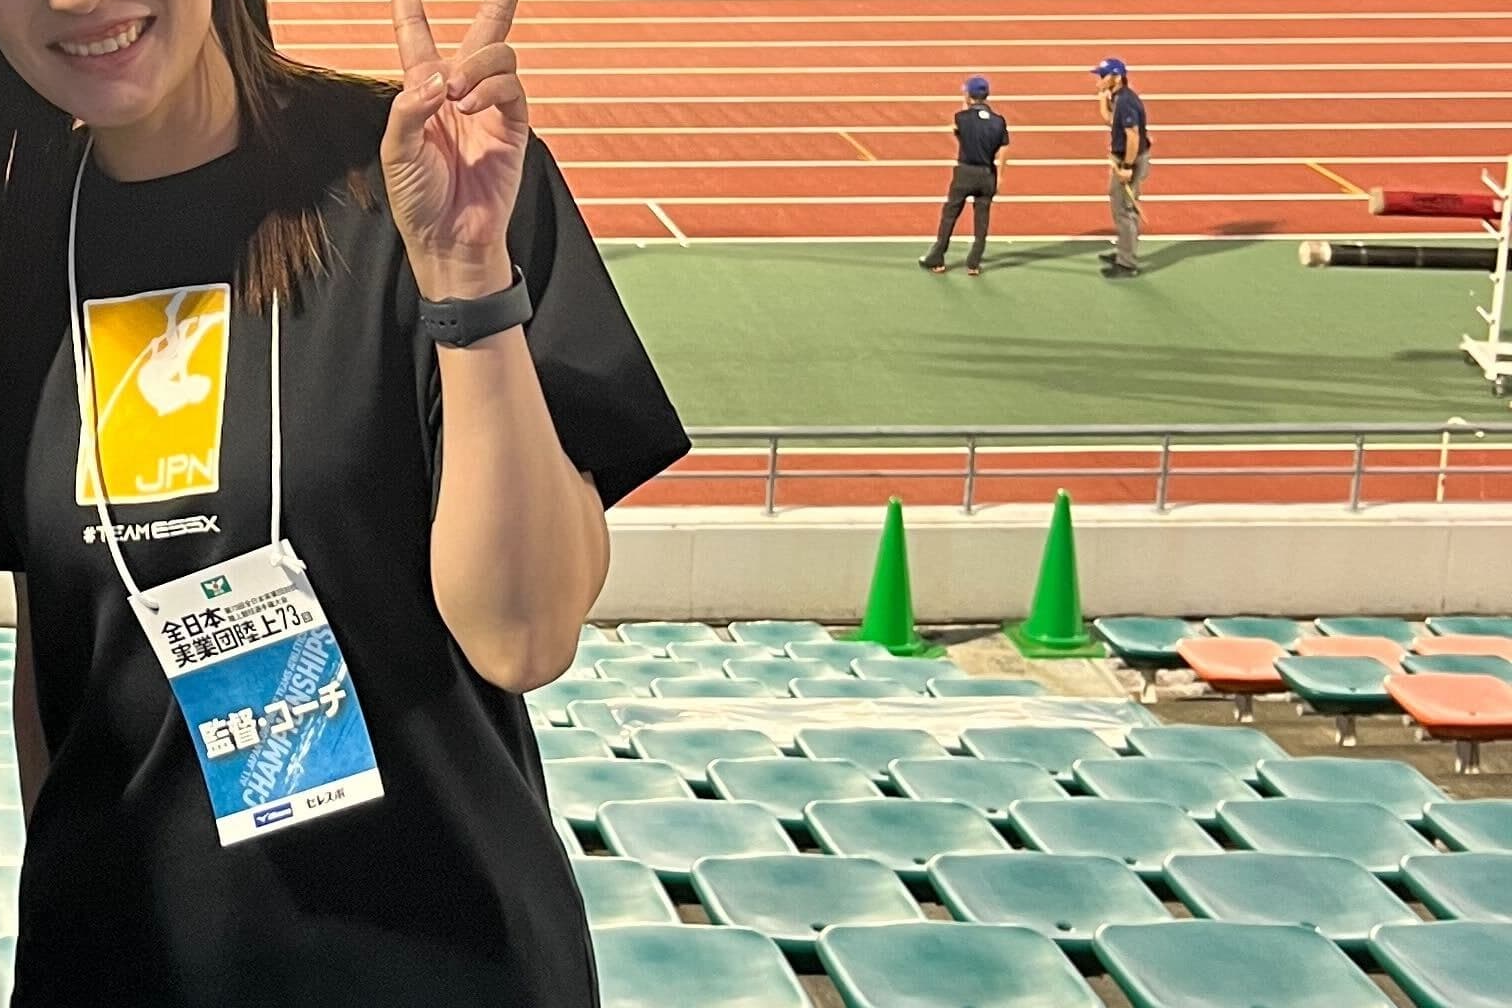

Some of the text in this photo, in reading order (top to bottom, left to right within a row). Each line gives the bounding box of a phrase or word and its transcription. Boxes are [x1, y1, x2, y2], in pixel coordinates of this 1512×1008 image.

[136, 447, 215, 492] JPN
[161, 607, 226, 644] 全日本
[198, 680, 347, 759] 監督・コーチ
[242, 629, 334, 807] CHAMPNSHIPS
